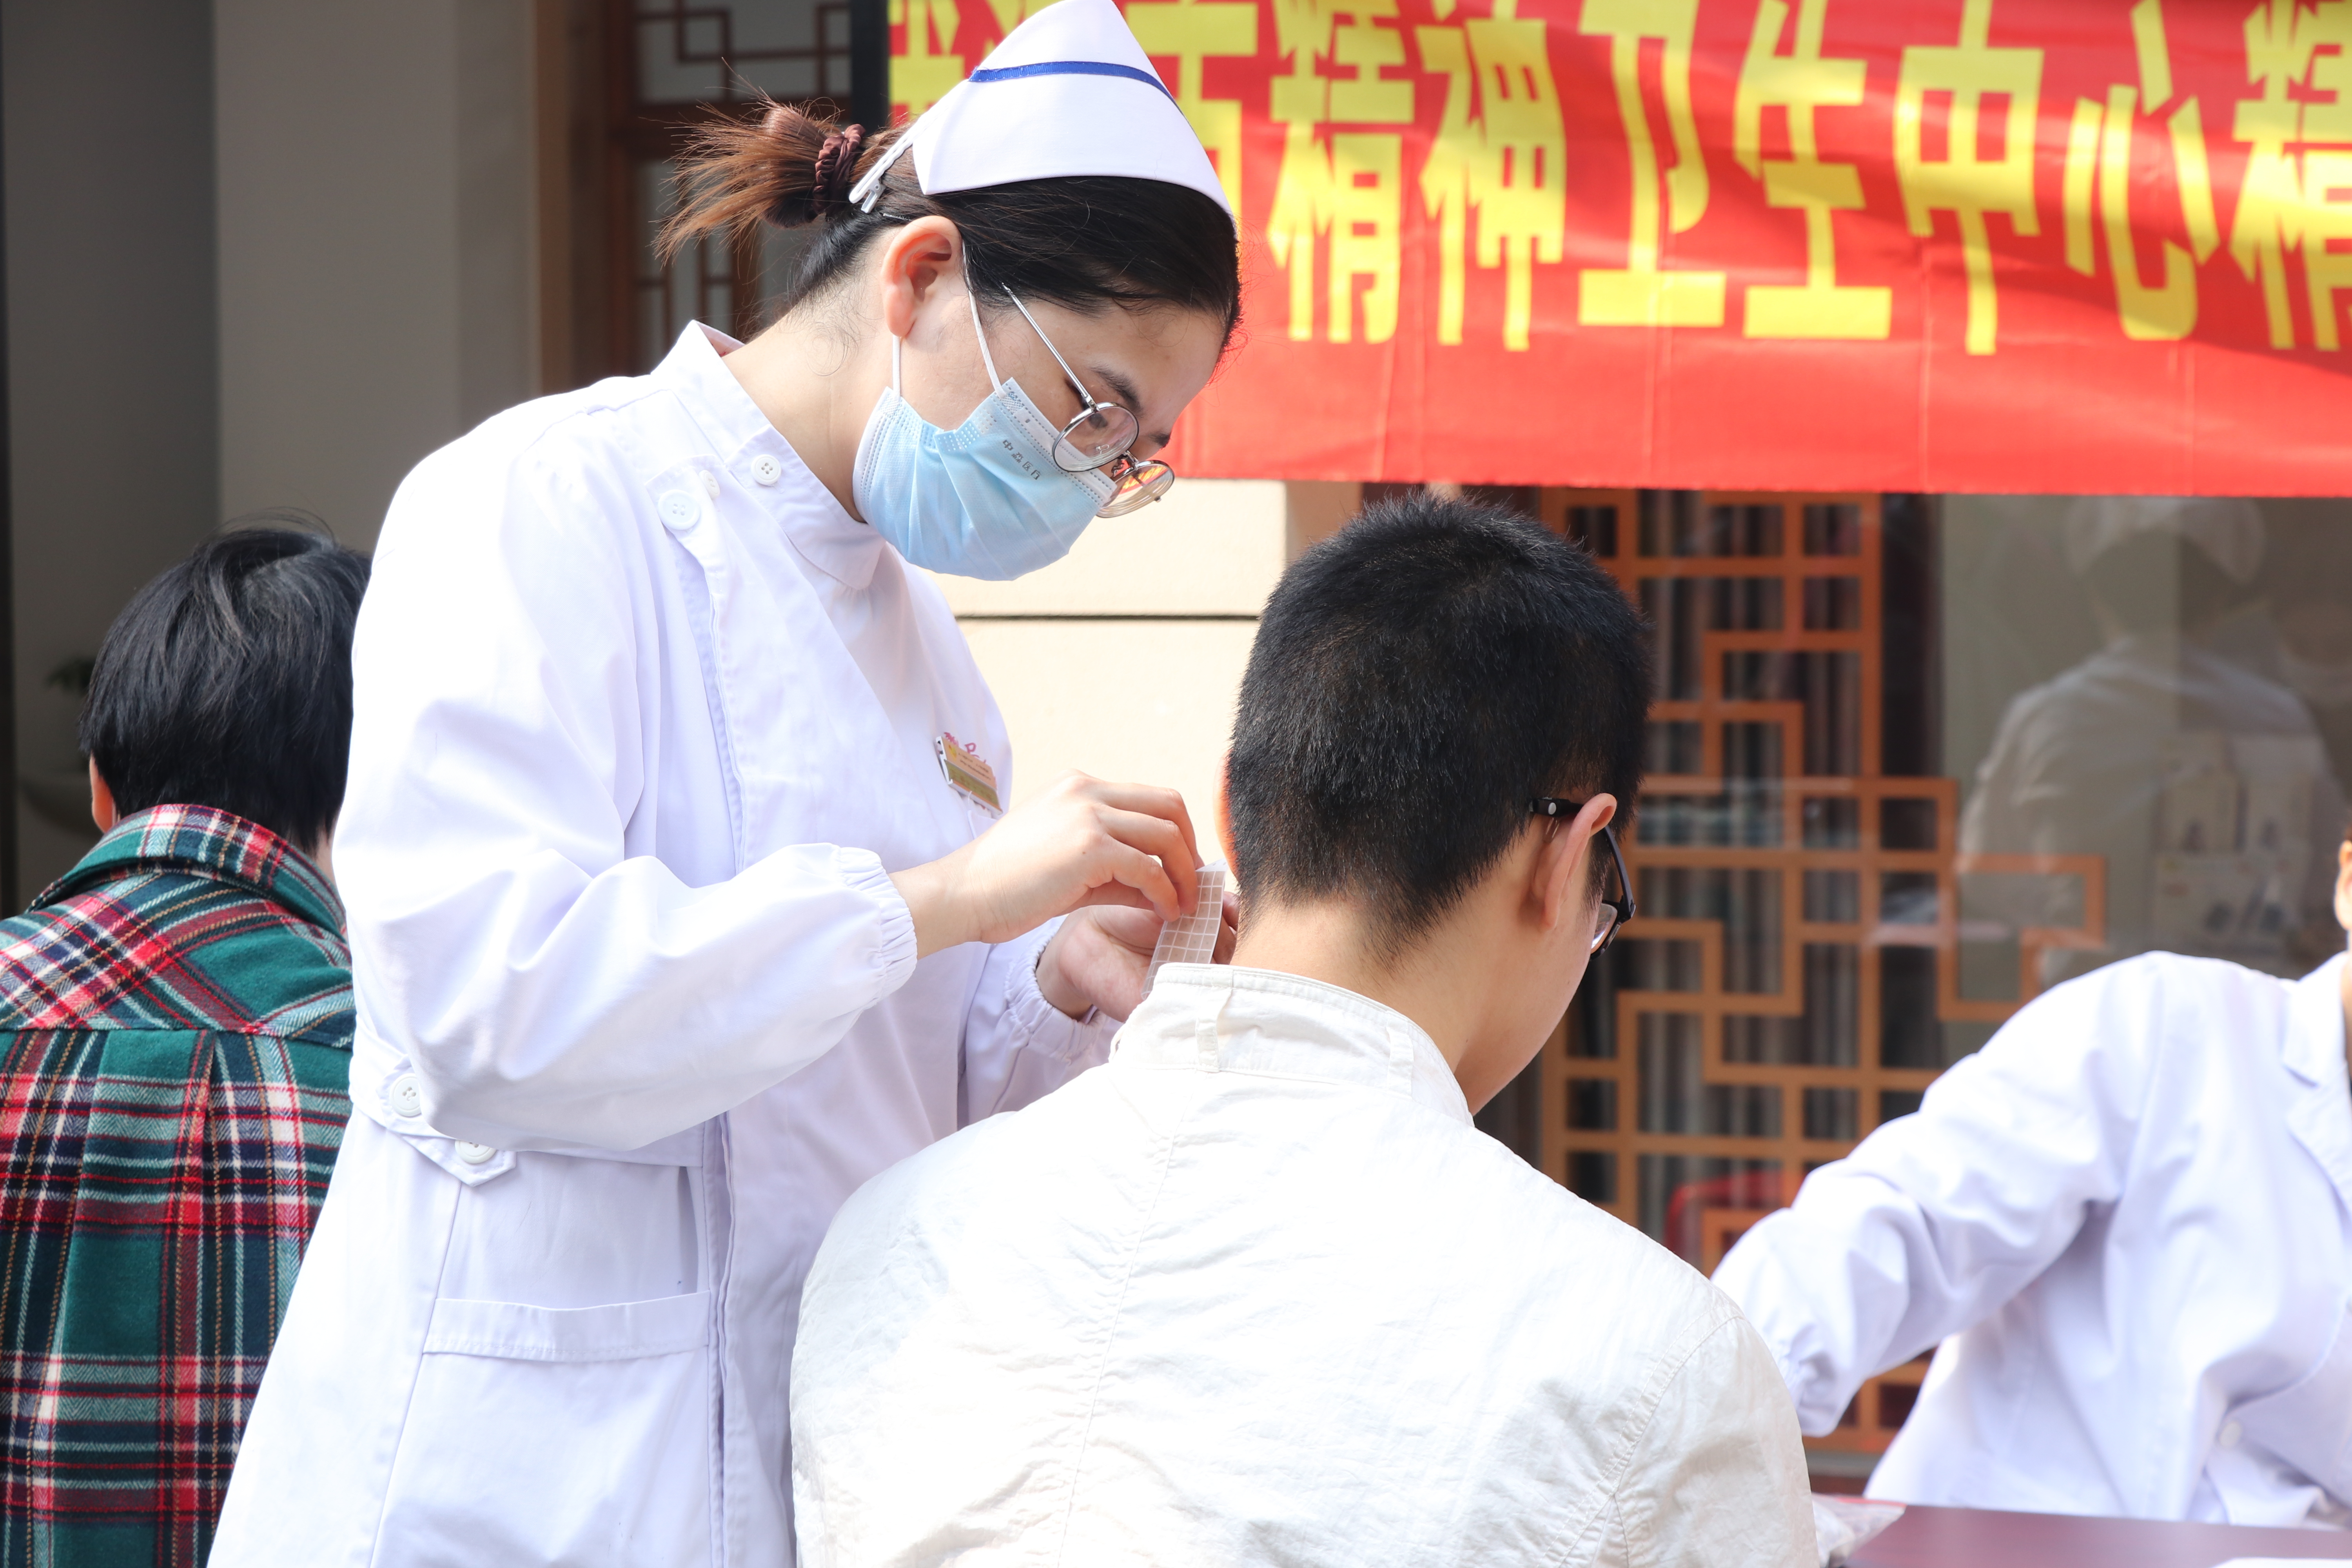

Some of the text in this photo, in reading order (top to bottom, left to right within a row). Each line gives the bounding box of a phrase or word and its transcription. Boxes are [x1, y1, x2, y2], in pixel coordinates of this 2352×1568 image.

[888, 0, 2352, 355] 精神卫生中心精
